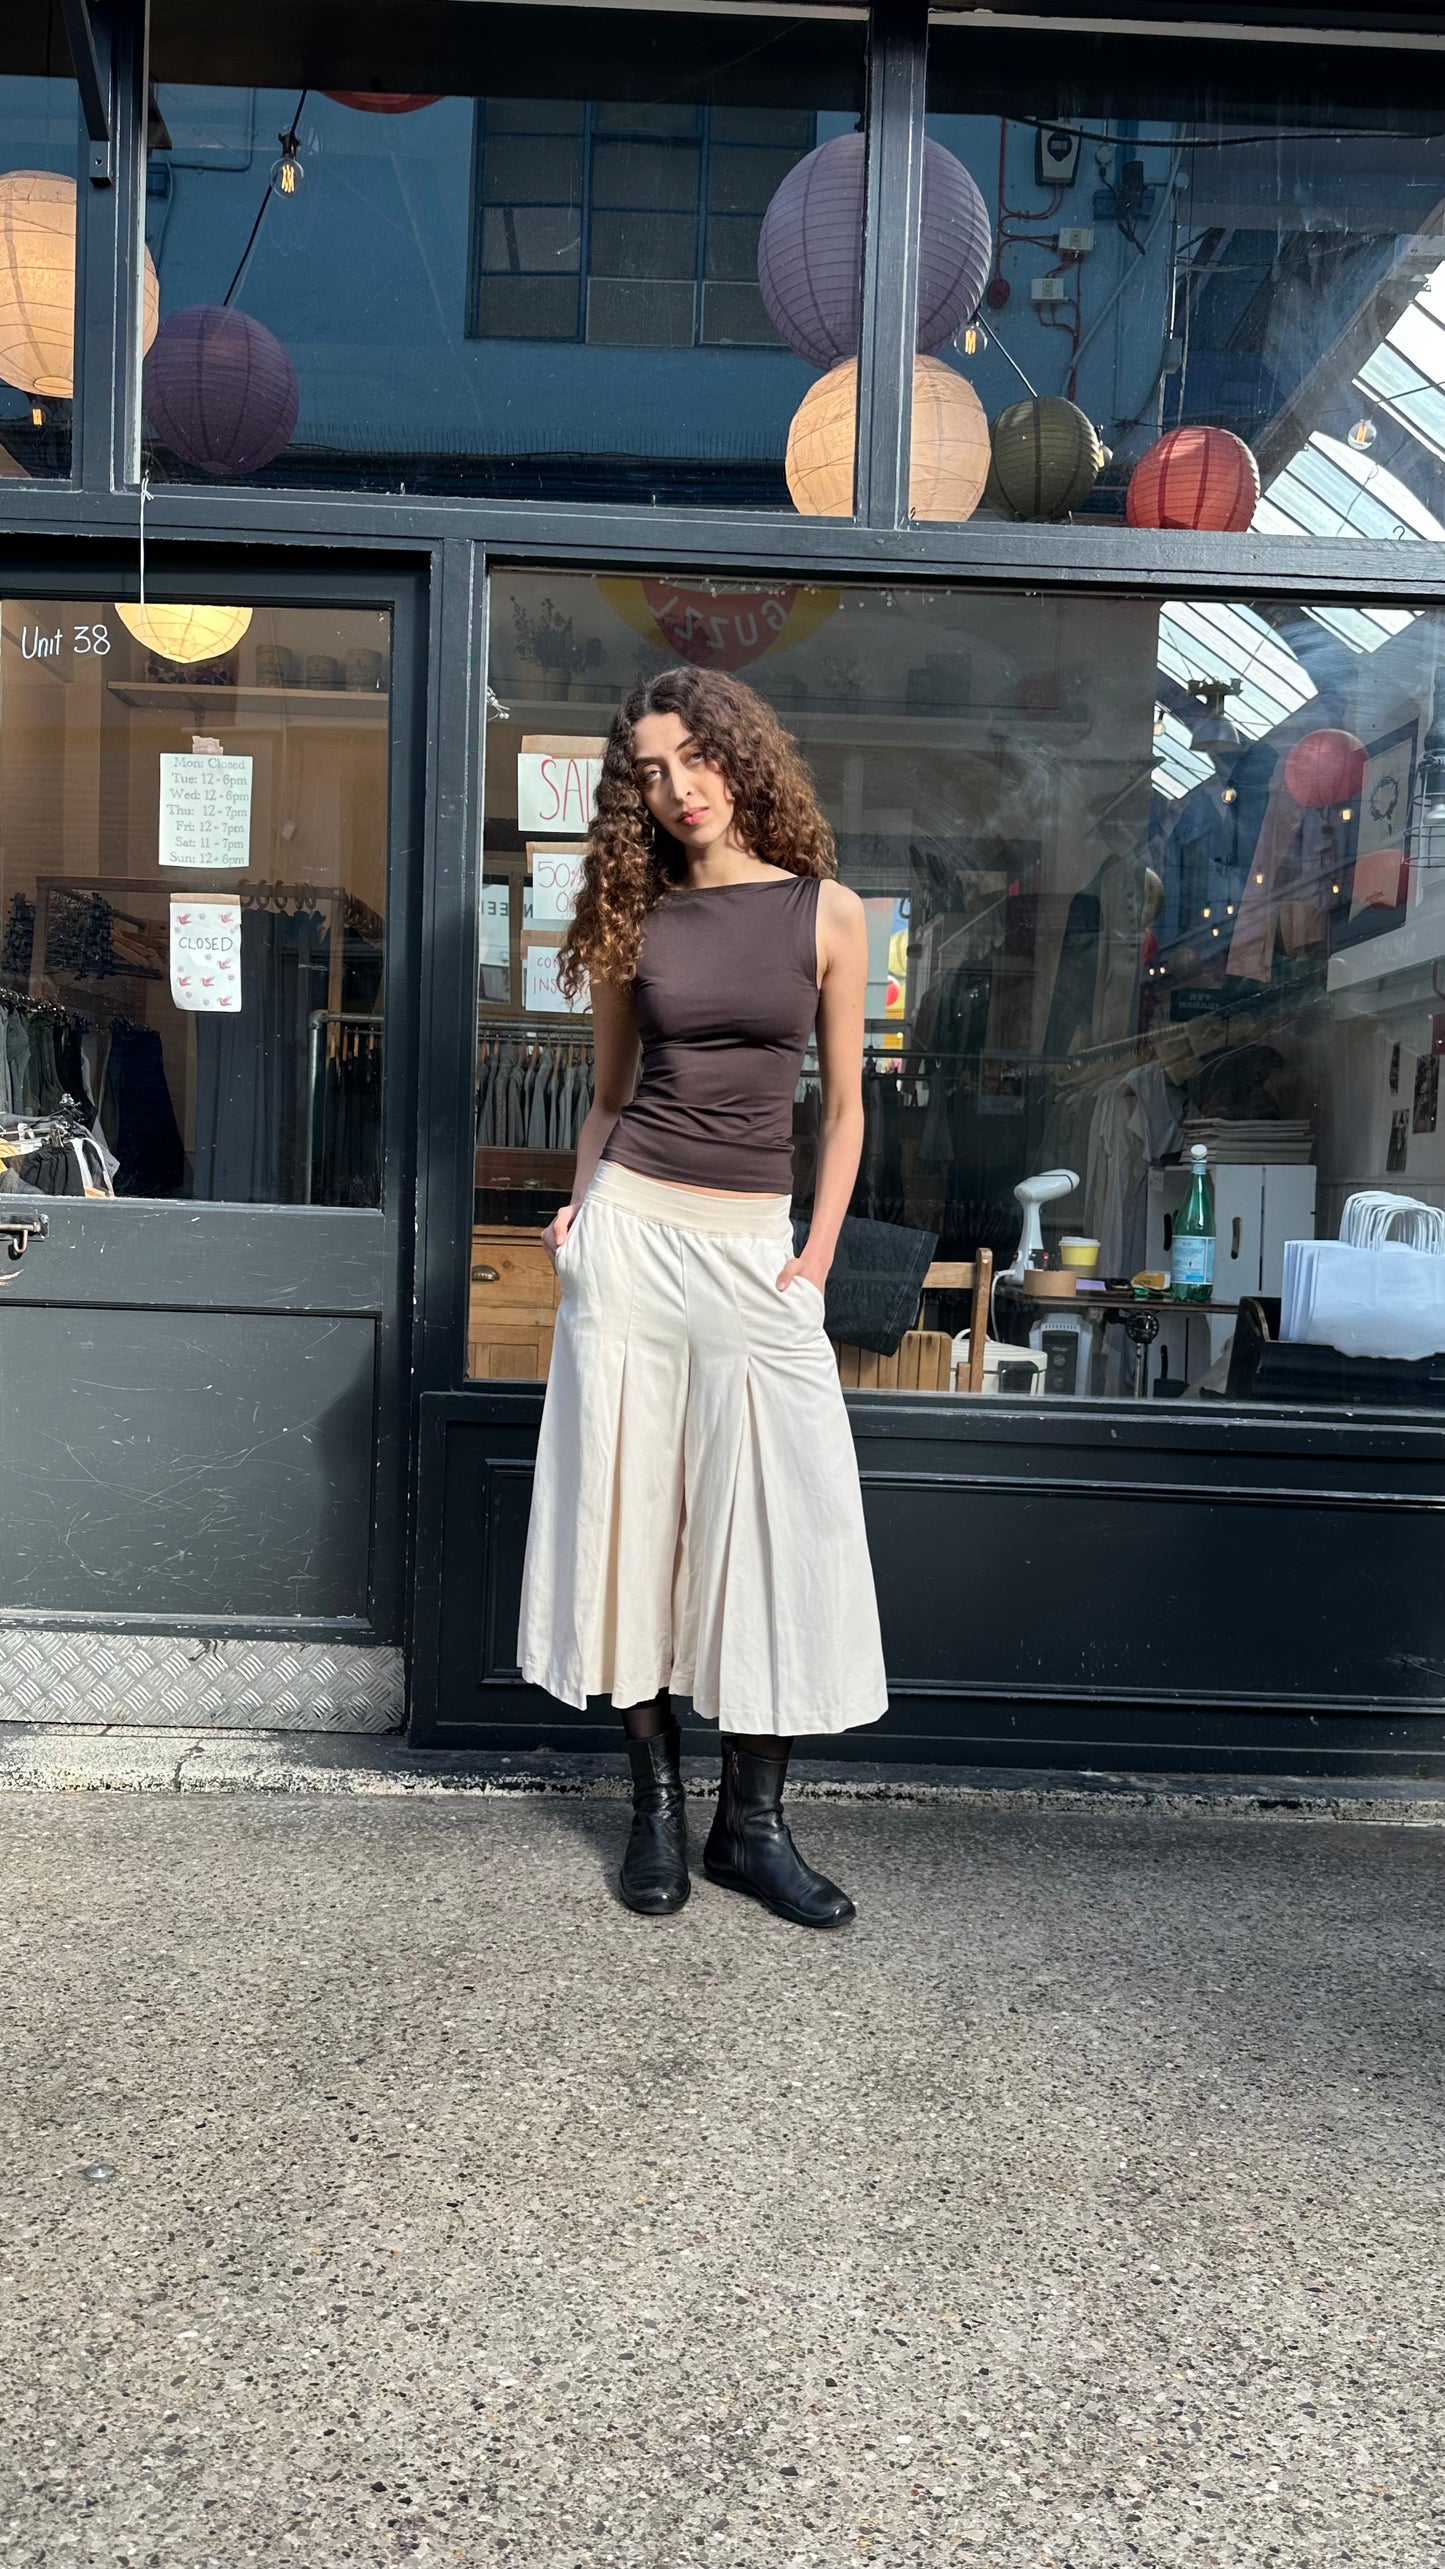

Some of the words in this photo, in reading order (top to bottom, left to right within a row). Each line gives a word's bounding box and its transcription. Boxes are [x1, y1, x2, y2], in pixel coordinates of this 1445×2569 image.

[22, 626, 63, 659] Unit
[74, 624, 110, 655] 38
[174, 757, 204, 768] Mon:
[207, 758, 245, 770] Closed
[171, 773, 197, 784] Tue:
[202, 773, 214, 785] 12
[223, 775, 247, 787] 6pm
[169, 788, 200, 800] Wed:
[204, 790, 216, 800] 12
[226, 791, 249, 803] 6pm
[539, 759, 589, 824] SAL
[166, 804, 194, 815] Thu:
[203, 805, 215, 816] 12
[225, 806, 247, 819] 7pm
[176, 821, 195, 831] Fri:
[200, 821, 211, 832] 12
[222, 823, 244, 835] 7pm
[175, 837, 195, 847] Sat:
[200, 838, 210, 848] 11
[223, 838, 243, 851] 7pm
[170, 852, 195, 863] Sun:
[200, 853, 212, 863] 12
[222, 854, 244, 866] 6pm
[178, 936, 233, 952] CLOSED
